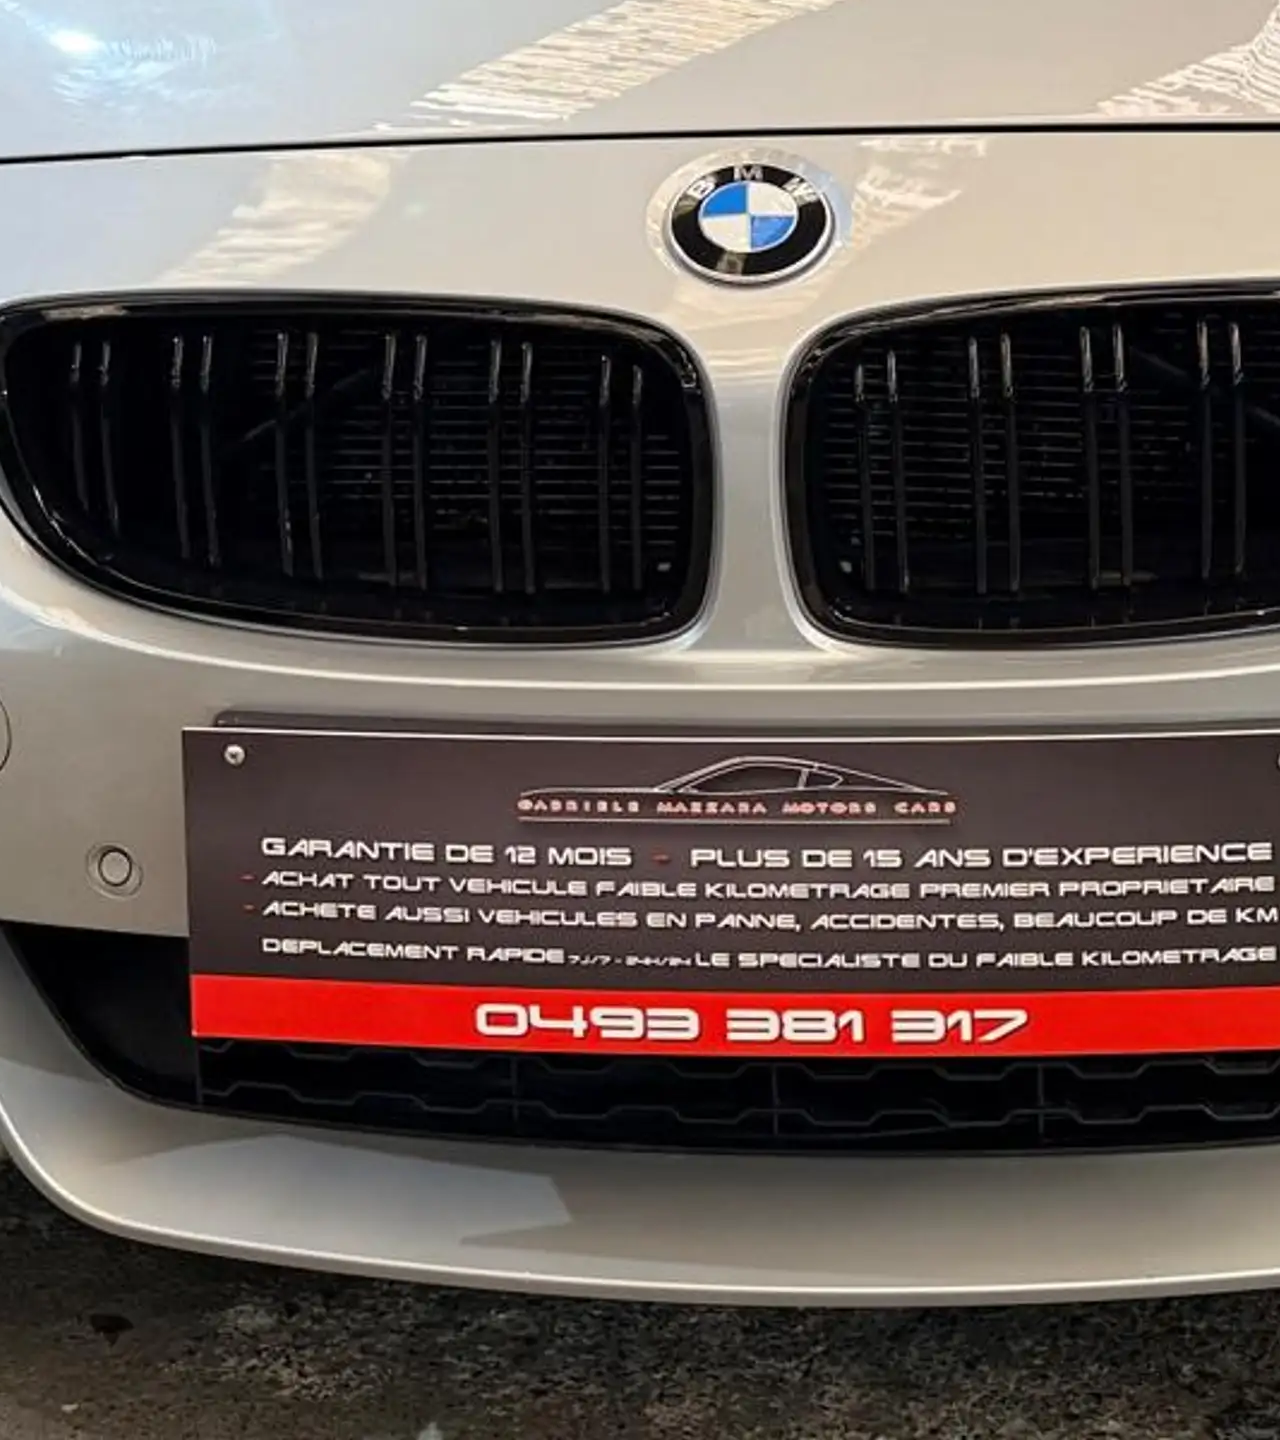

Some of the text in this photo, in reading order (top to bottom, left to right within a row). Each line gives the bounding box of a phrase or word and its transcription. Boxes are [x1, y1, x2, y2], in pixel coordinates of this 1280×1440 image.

[687, 164, 819, 203] BMW
[781, 801, 877, 816] MOTORS
[894, 800, 957, 815] CARS
[261, 837, 436, 862] GARANTIE
[444, 844, 494, 864] DE
[505, 846, 536, 865] 12
[548, 847, 633, 867] MOIS
[690, 849, 790, 869] PLUS
[802, 849, 853, 869] DE
[863, 849, 902, 869] 15
[914, 848, 992, 869] ANS
[1003, 842, 1273, 868] D'EXPERIENCE
[261, 870, 1276, 901] ACHAT TOUT VEHICULE FAIBLE KILOMETRAGE PREMIER PROPRIETAIRE
[262, 900, 1280, 933] ACHETE AUSSI VEHICULES EN PANNE, ACCIDENTES, BEAUCOUP DE KM
[262, 937, 460, 960] DEPLACEMENT
[467, 945, 566, 965] RAPIDE
[695, 950, 730, 968] LE
[739, 951, 920, 969] SPECIALISTE
[928, 951, 968, 968] DU
[976, 951, 1074, 968] FAIBLE
[1082, 945, 1277, 967] KILOMETRAGE
[474, 1002, 1029, 1043] 0493 381 317
